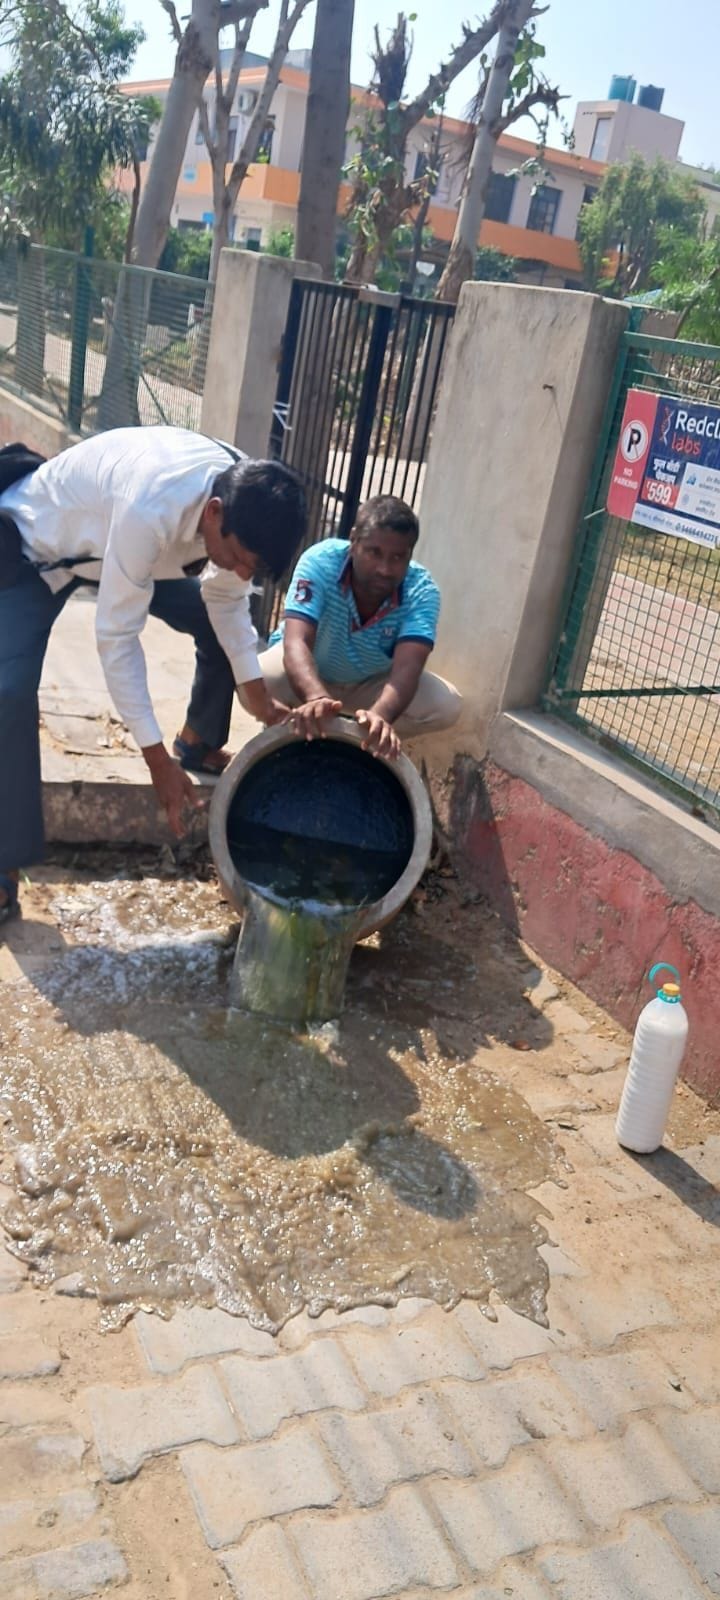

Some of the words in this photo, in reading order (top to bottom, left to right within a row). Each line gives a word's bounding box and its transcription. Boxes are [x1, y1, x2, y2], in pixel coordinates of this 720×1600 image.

[675, 409, 720, 440] Redcl
[671, 432, 701, 455] labs
[613, 475, 638, 490] PARKING
[623, 467, 633, 477] NO
[294, 579, 312, 603] 5
